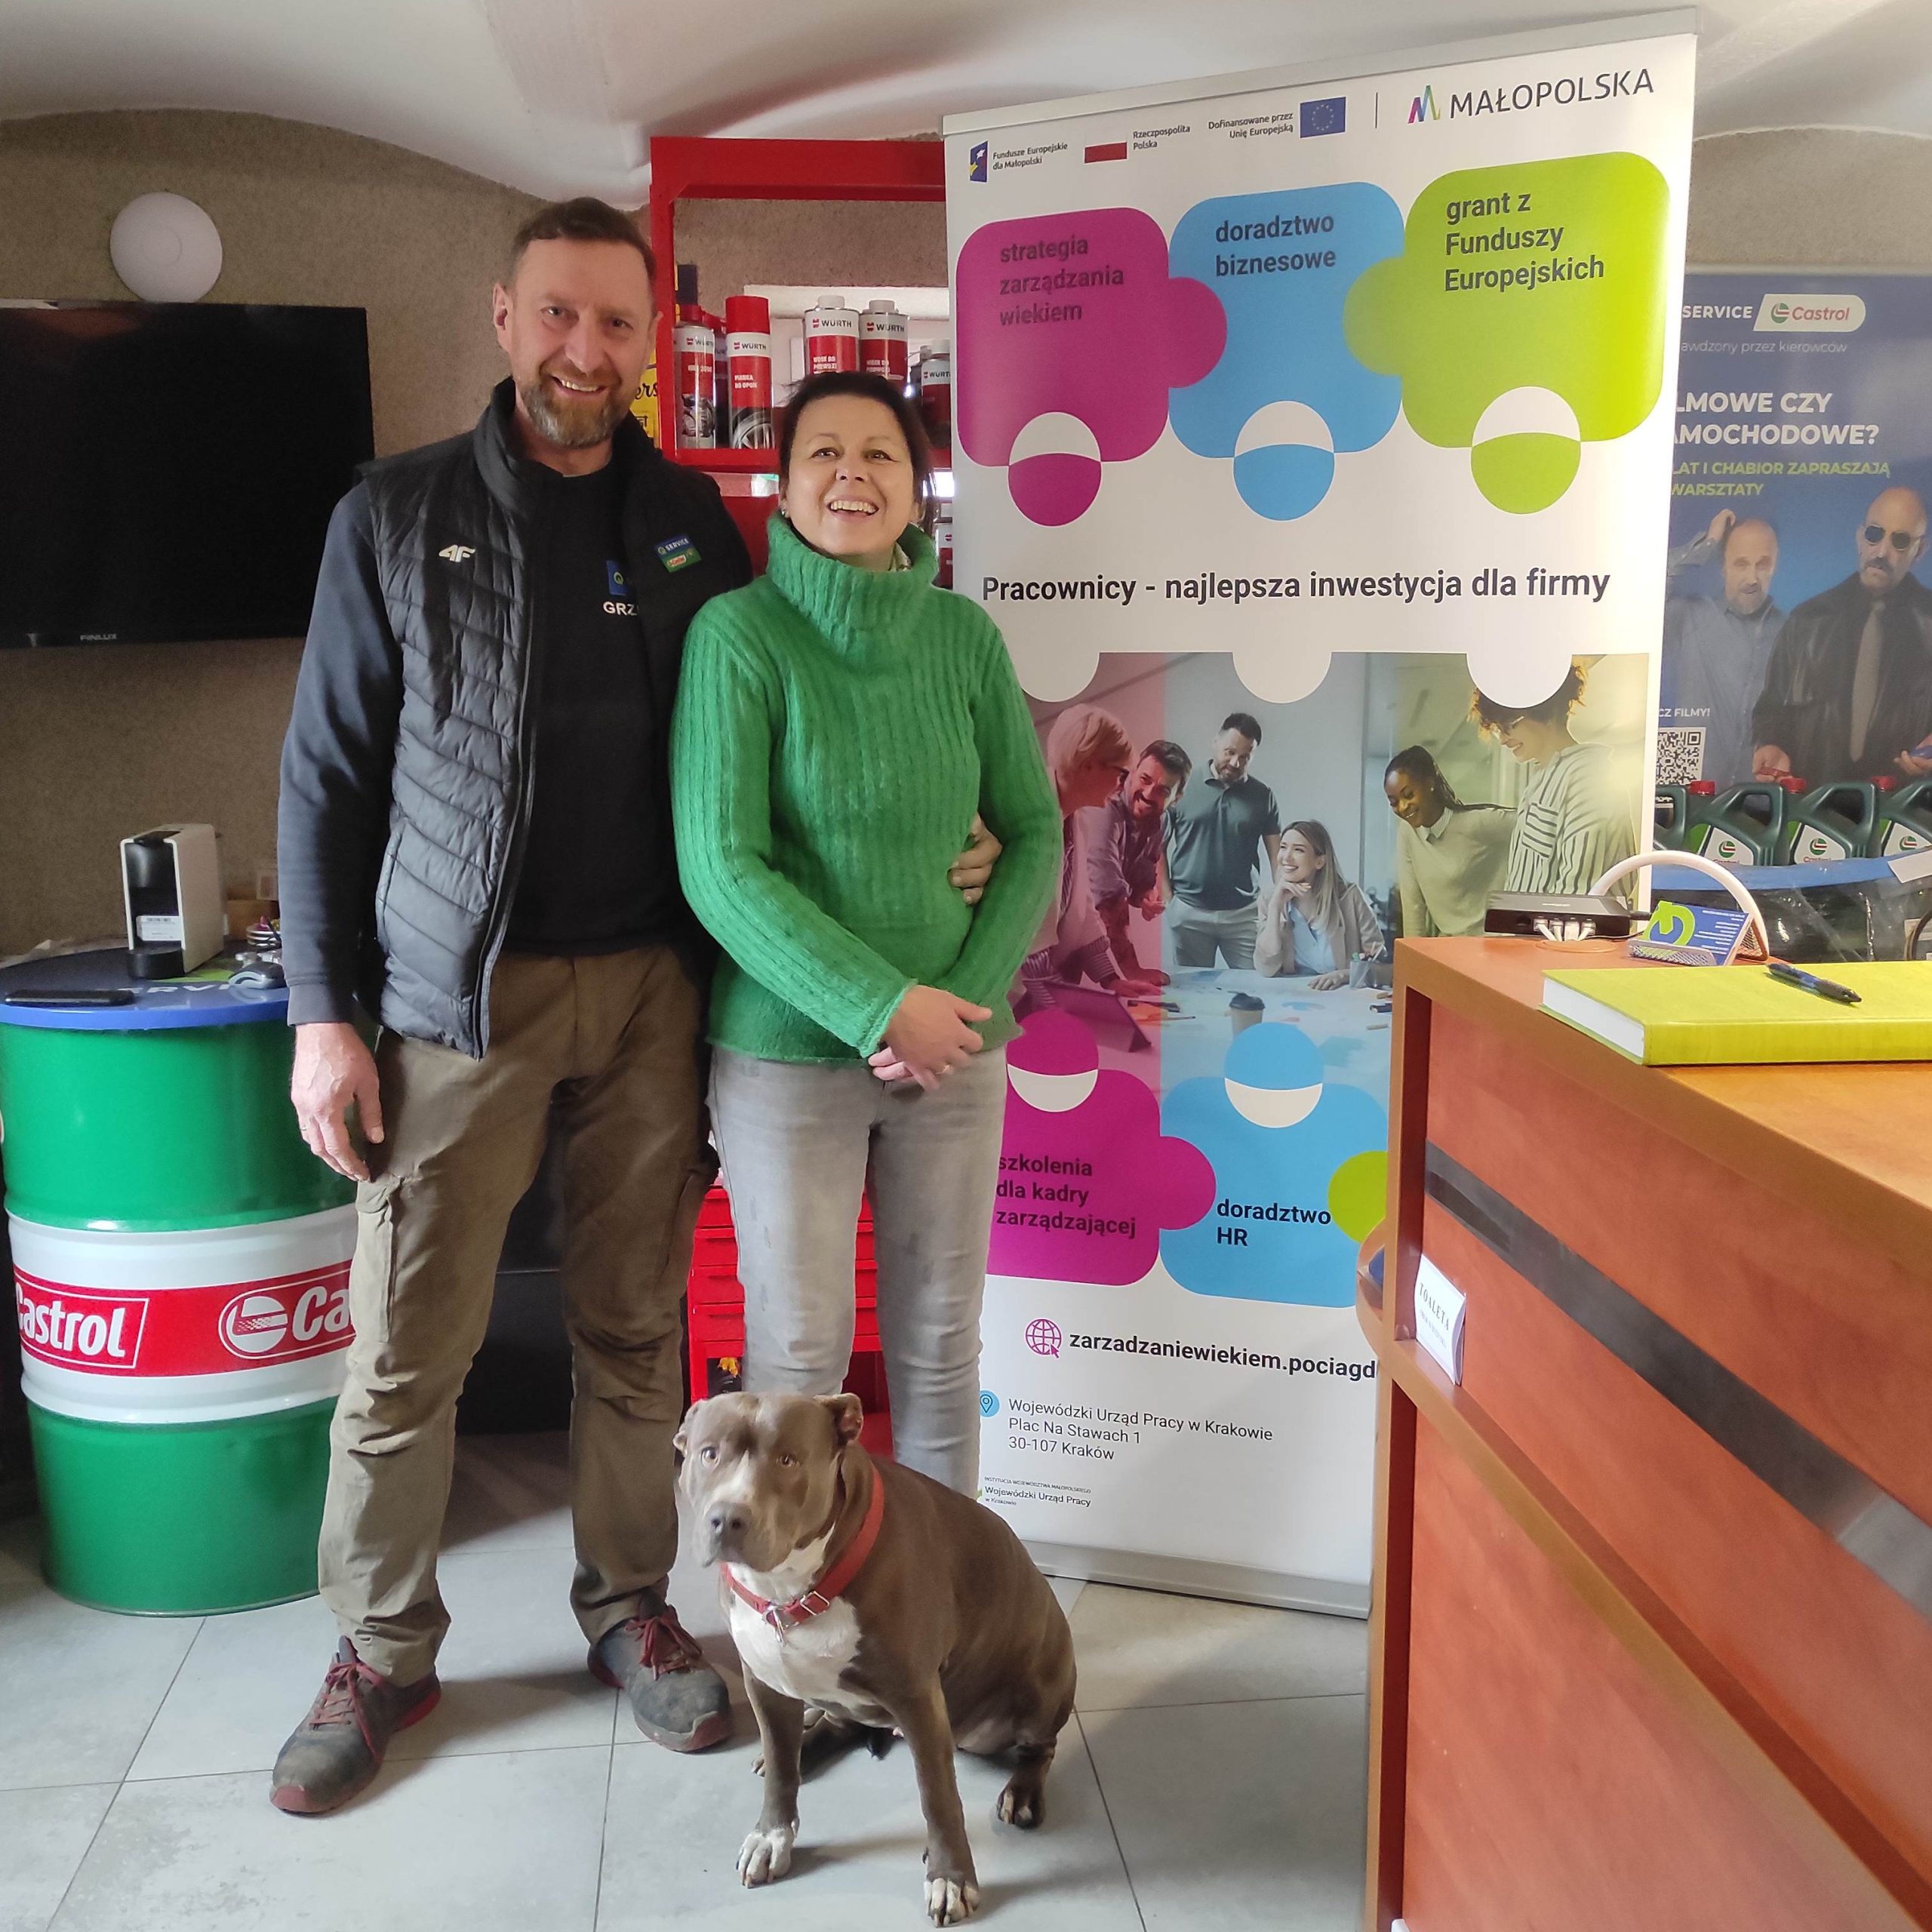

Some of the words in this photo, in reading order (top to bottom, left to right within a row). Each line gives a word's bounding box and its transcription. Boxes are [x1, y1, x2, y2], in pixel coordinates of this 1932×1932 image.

[1450, 68, 1654, 119] MAŁOPOLSKA
[1133, 124, 1191, 139] Rzeczpospolita
[1208, 115, 1269, 130] Dofinansowane
[1271, 112, 1294, 124] przez
[1229, 128, 1247, 139] Unię
[1249, 122, 1294, 135] Europejską
[992, 149, 1026, 160] Fundusze
[1027, 142, 1068, 155] Europejskie
[1133, 140, 1158, 150] Polska
[992, 161, 1003, 170] dla
[1004, 155, 1042, 168] Małopolski
[1446, 192, 1511, 225] grant
[1517, 193, 1531, 212] z
[1215, 212, 1334, 242] doradztwo
[1000, 234, 1088, 263] strategia
[1445, 225, 1564, 256] Funduszy
[1215, 249, 1336, 278] biznesowe
[1444, 254, 1604, 293] Europejskich
[1000, 265, 1124, 296] zarządzania
[1000, 301, 1082, 326] wiekiem
[1681, 305, 1753, 319] SERVICE
[1792, 306, 1850, 321] Castrol
[1741, 342, 1776, 354] przez
[1780, 340, 1847, 353] kierowców
[1780, 392, 1833, 414] CZY
[1674, 424, 1880, 445] MOCHODOWE?
[1703, 462, 1708, 475] I
[1712, 462, 1783, 475] CHABIOR
[1787, 462, 1891, 478] ZAPRASZAJĄ
[438, 544, 476, 562] 4F
[983, 574, 1137, 606] Pracownicy
[1165, 571, 1300, 605] najlepsza
[1310, 569, 1462, 604] inwestycja
[1472, 568, 1516, 596] dla
[1526, 567, 1611, 603] firmy
[603, 601, 639, 617] GRZ
[1674, 707, 1711, 718] FILMY!
[998, 1153, 1093, 1177] szkolenia
[996, 1179, 1026, 1199] dla
[1032, 1182, 1089, 1208] kadry
[1217, 1198, 1332, 1225] doradztwo
[996, 1210, 1137, 1239] zarządzającej
[1216, 1226, 1249, 1247] HR
[1419, 1282, 1449, 1331] TOALETA
[1069, 1331, 1376, 1382] zarzadzaniewiekiem.pociagd
[1008, 1398, 1093, 1420] Wojewódzki
[1096, 1408, 1139, 1426] Urząd
[1143, 1413, 1184, 1432] Pracy
[1189, 1420, 1201, 1432] w
[1204, 1419, 1273, 1441] Krakowie
[1008, 1417, 1039, 1432] Plac
[1044, 1421, 1063, 1435] Na
[1066, 1423, 1129, 1443] Stawach
[1134, 1432, 1140, 1444] 1
[1008, 1436, 1057, 1454] 30-107
[1061, 1441, 1115, 1460] Kraków
[984, 1485, 1037, 1500] Wojewódzki
[1038, 1491, 1064, 1505] Urząd
[1066, 1495, 1092, 1509] Pracy
